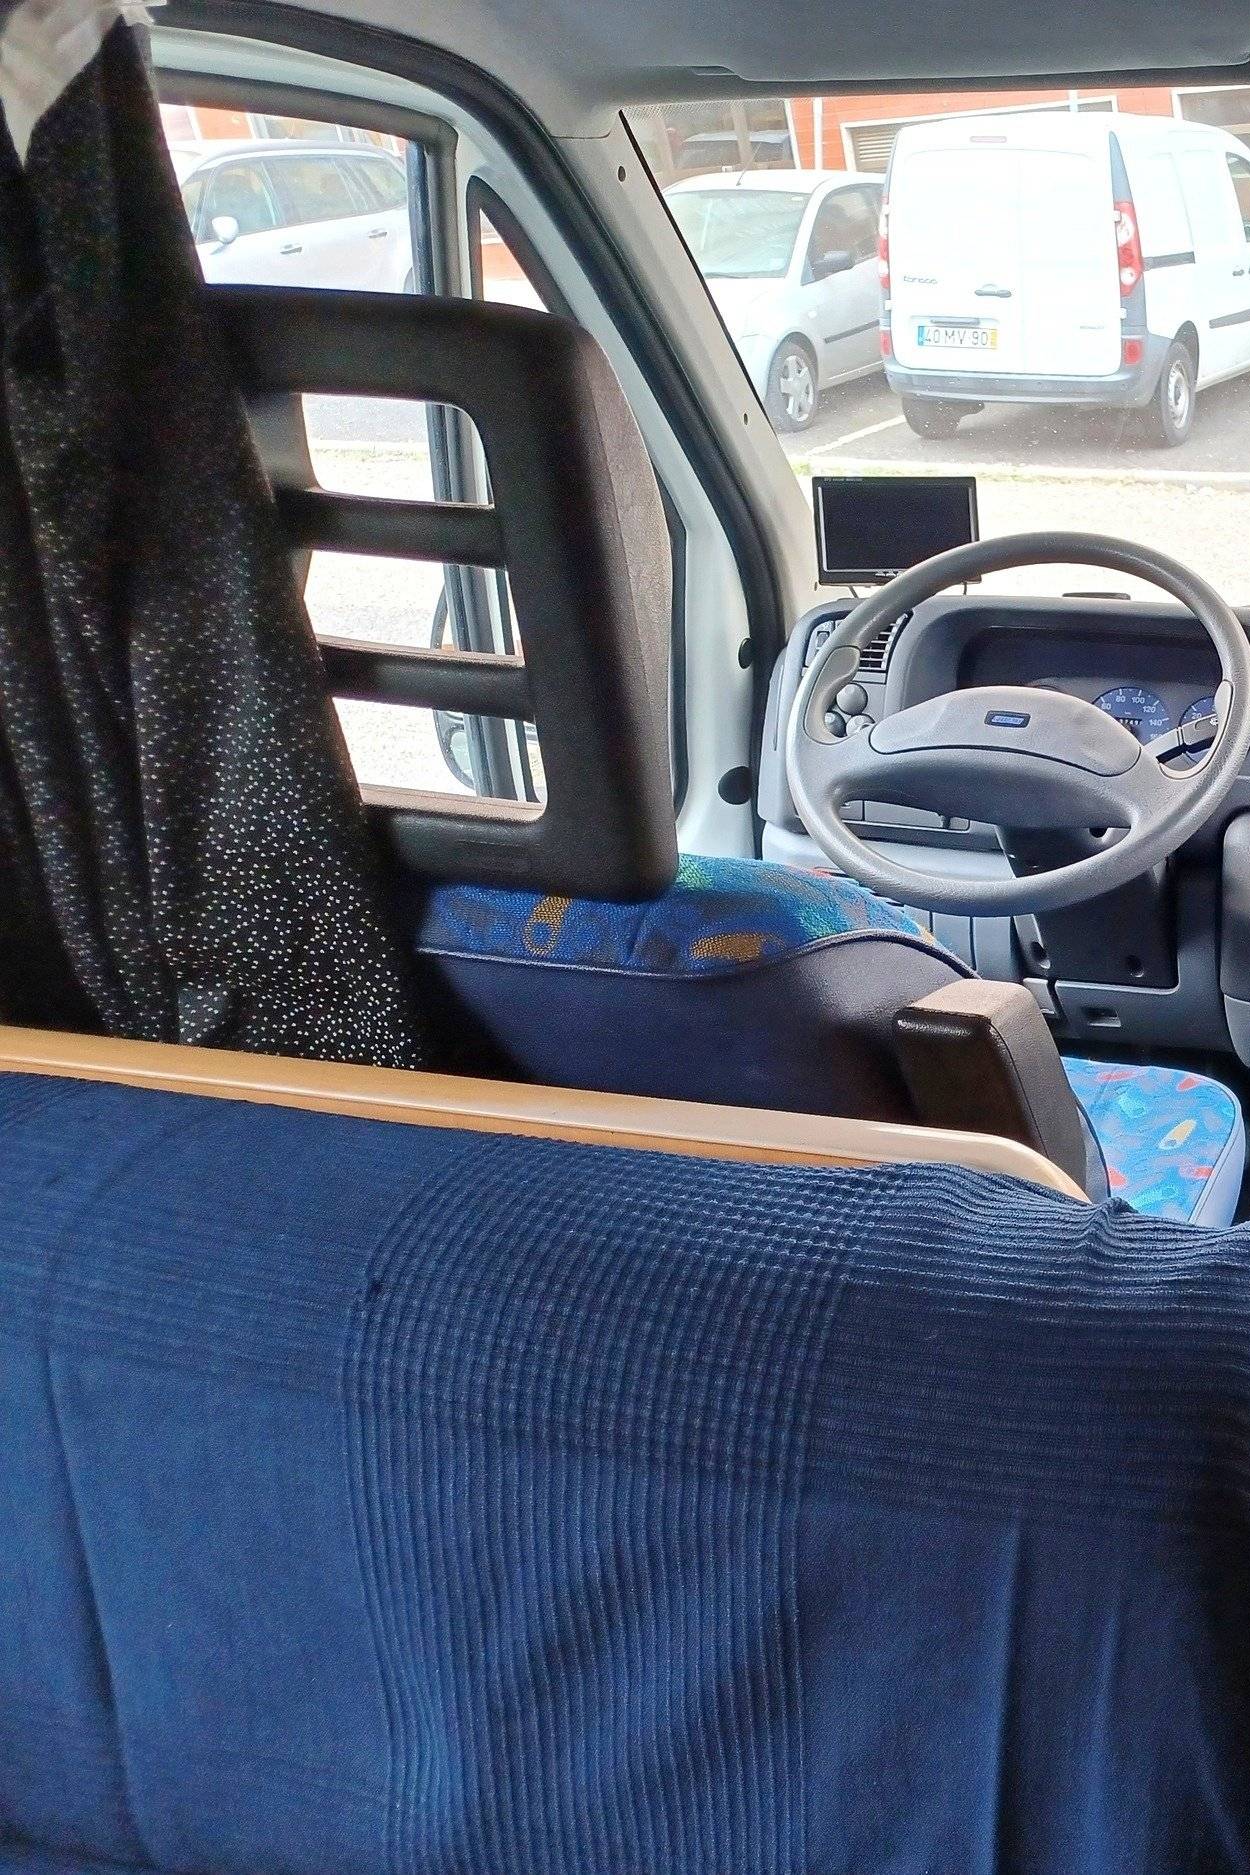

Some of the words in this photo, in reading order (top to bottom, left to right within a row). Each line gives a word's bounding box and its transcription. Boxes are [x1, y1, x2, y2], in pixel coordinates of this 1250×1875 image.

[1115, 695, 1126, 703] 80
[1131, 696, 1146, 704] 100
[1142, 705, 1157, 713] 120
[1149, 718, 1163, 727] 140
